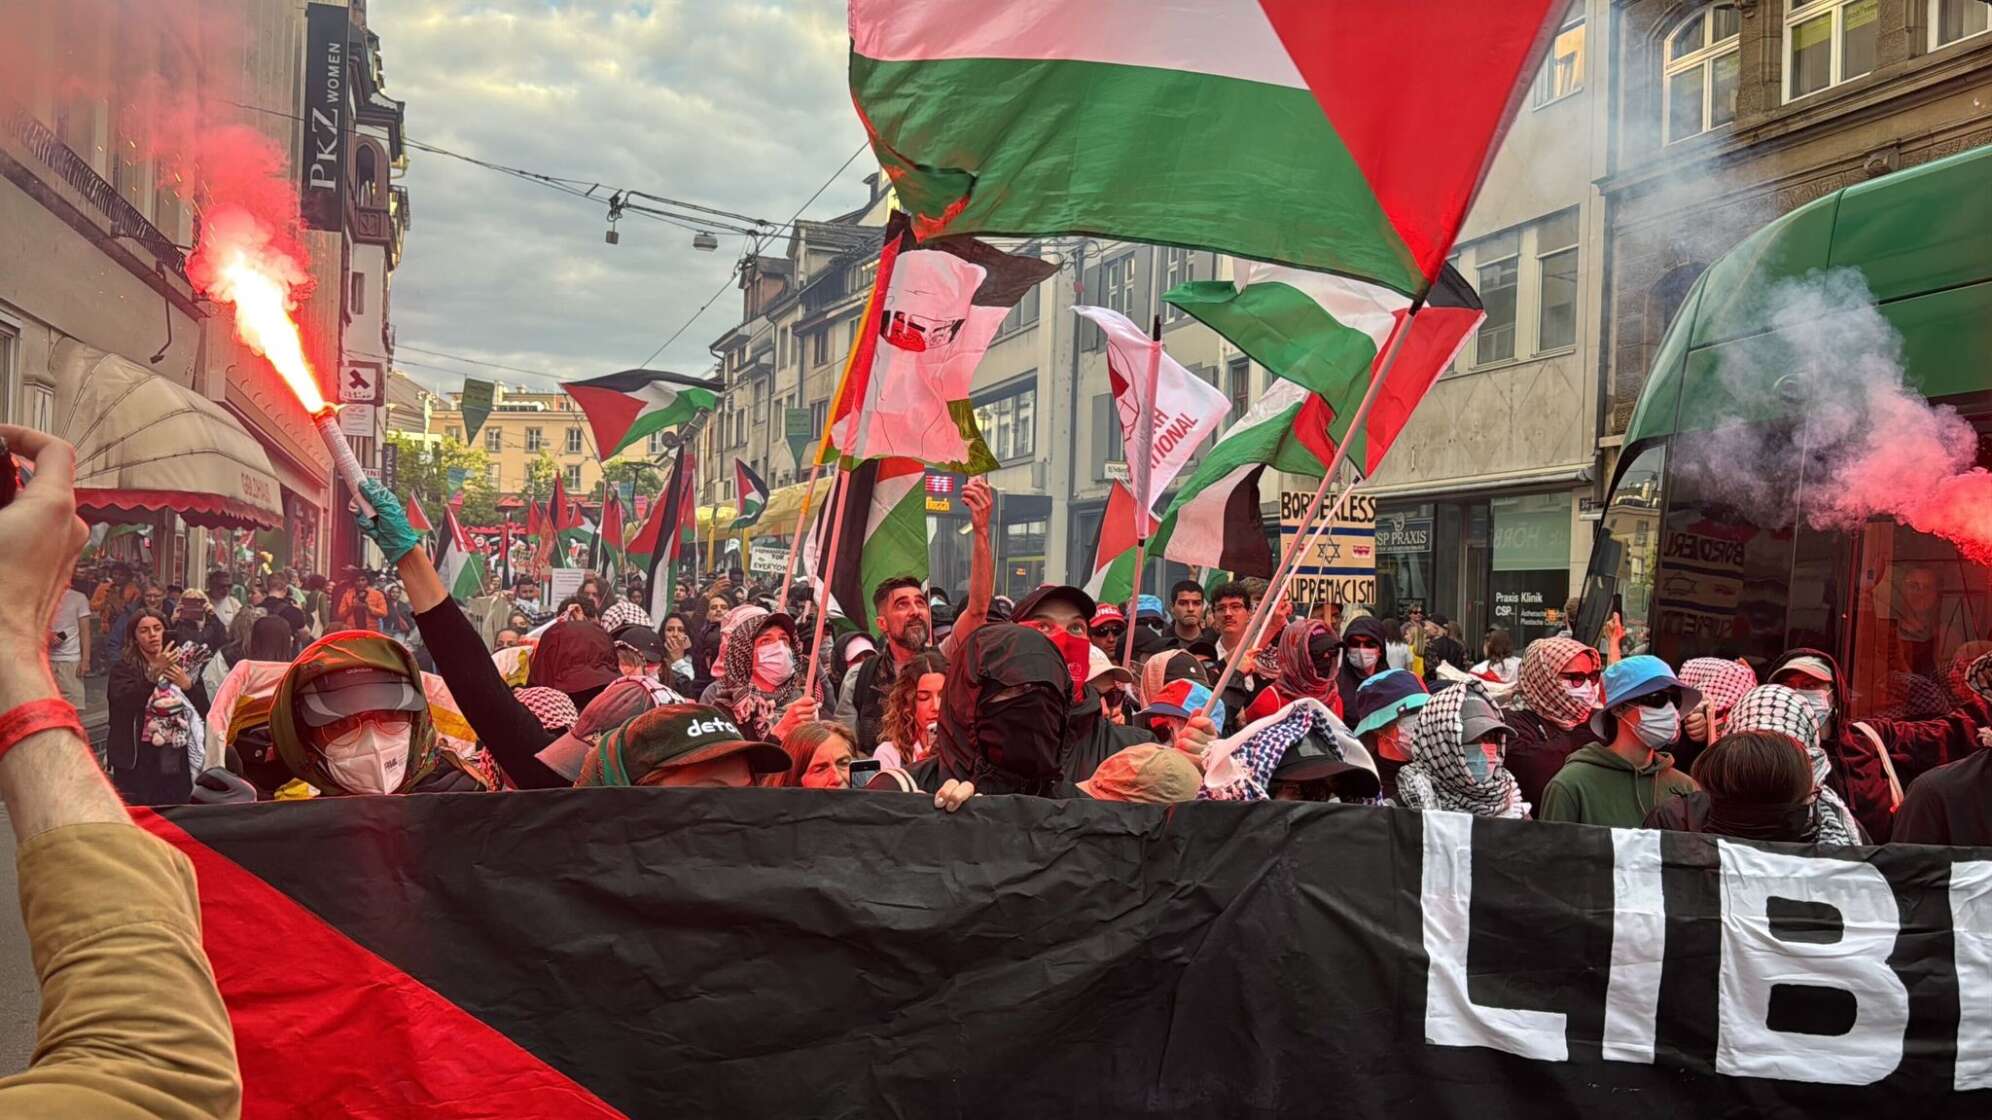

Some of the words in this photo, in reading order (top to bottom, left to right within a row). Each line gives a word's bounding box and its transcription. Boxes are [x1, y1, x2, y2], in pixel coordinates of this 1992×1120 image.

[309, 107, 338, 193] PKZ
[327, 42, 341, 103] WOMEN
[1151, 412, 1198, 469] TIONAL
[1376, 531, 1389, 546] SP
[1391, 530, 1427, 545] PRAXIS
[754, 562, 787, 571] EVERYON
[1496, 592, 1519, 603] Praxis
[1521, 592, 1543, 603] Klinik
[1495, 605, 1512, 617] CSP
[1420, 811, 1992, 1091] LIB
